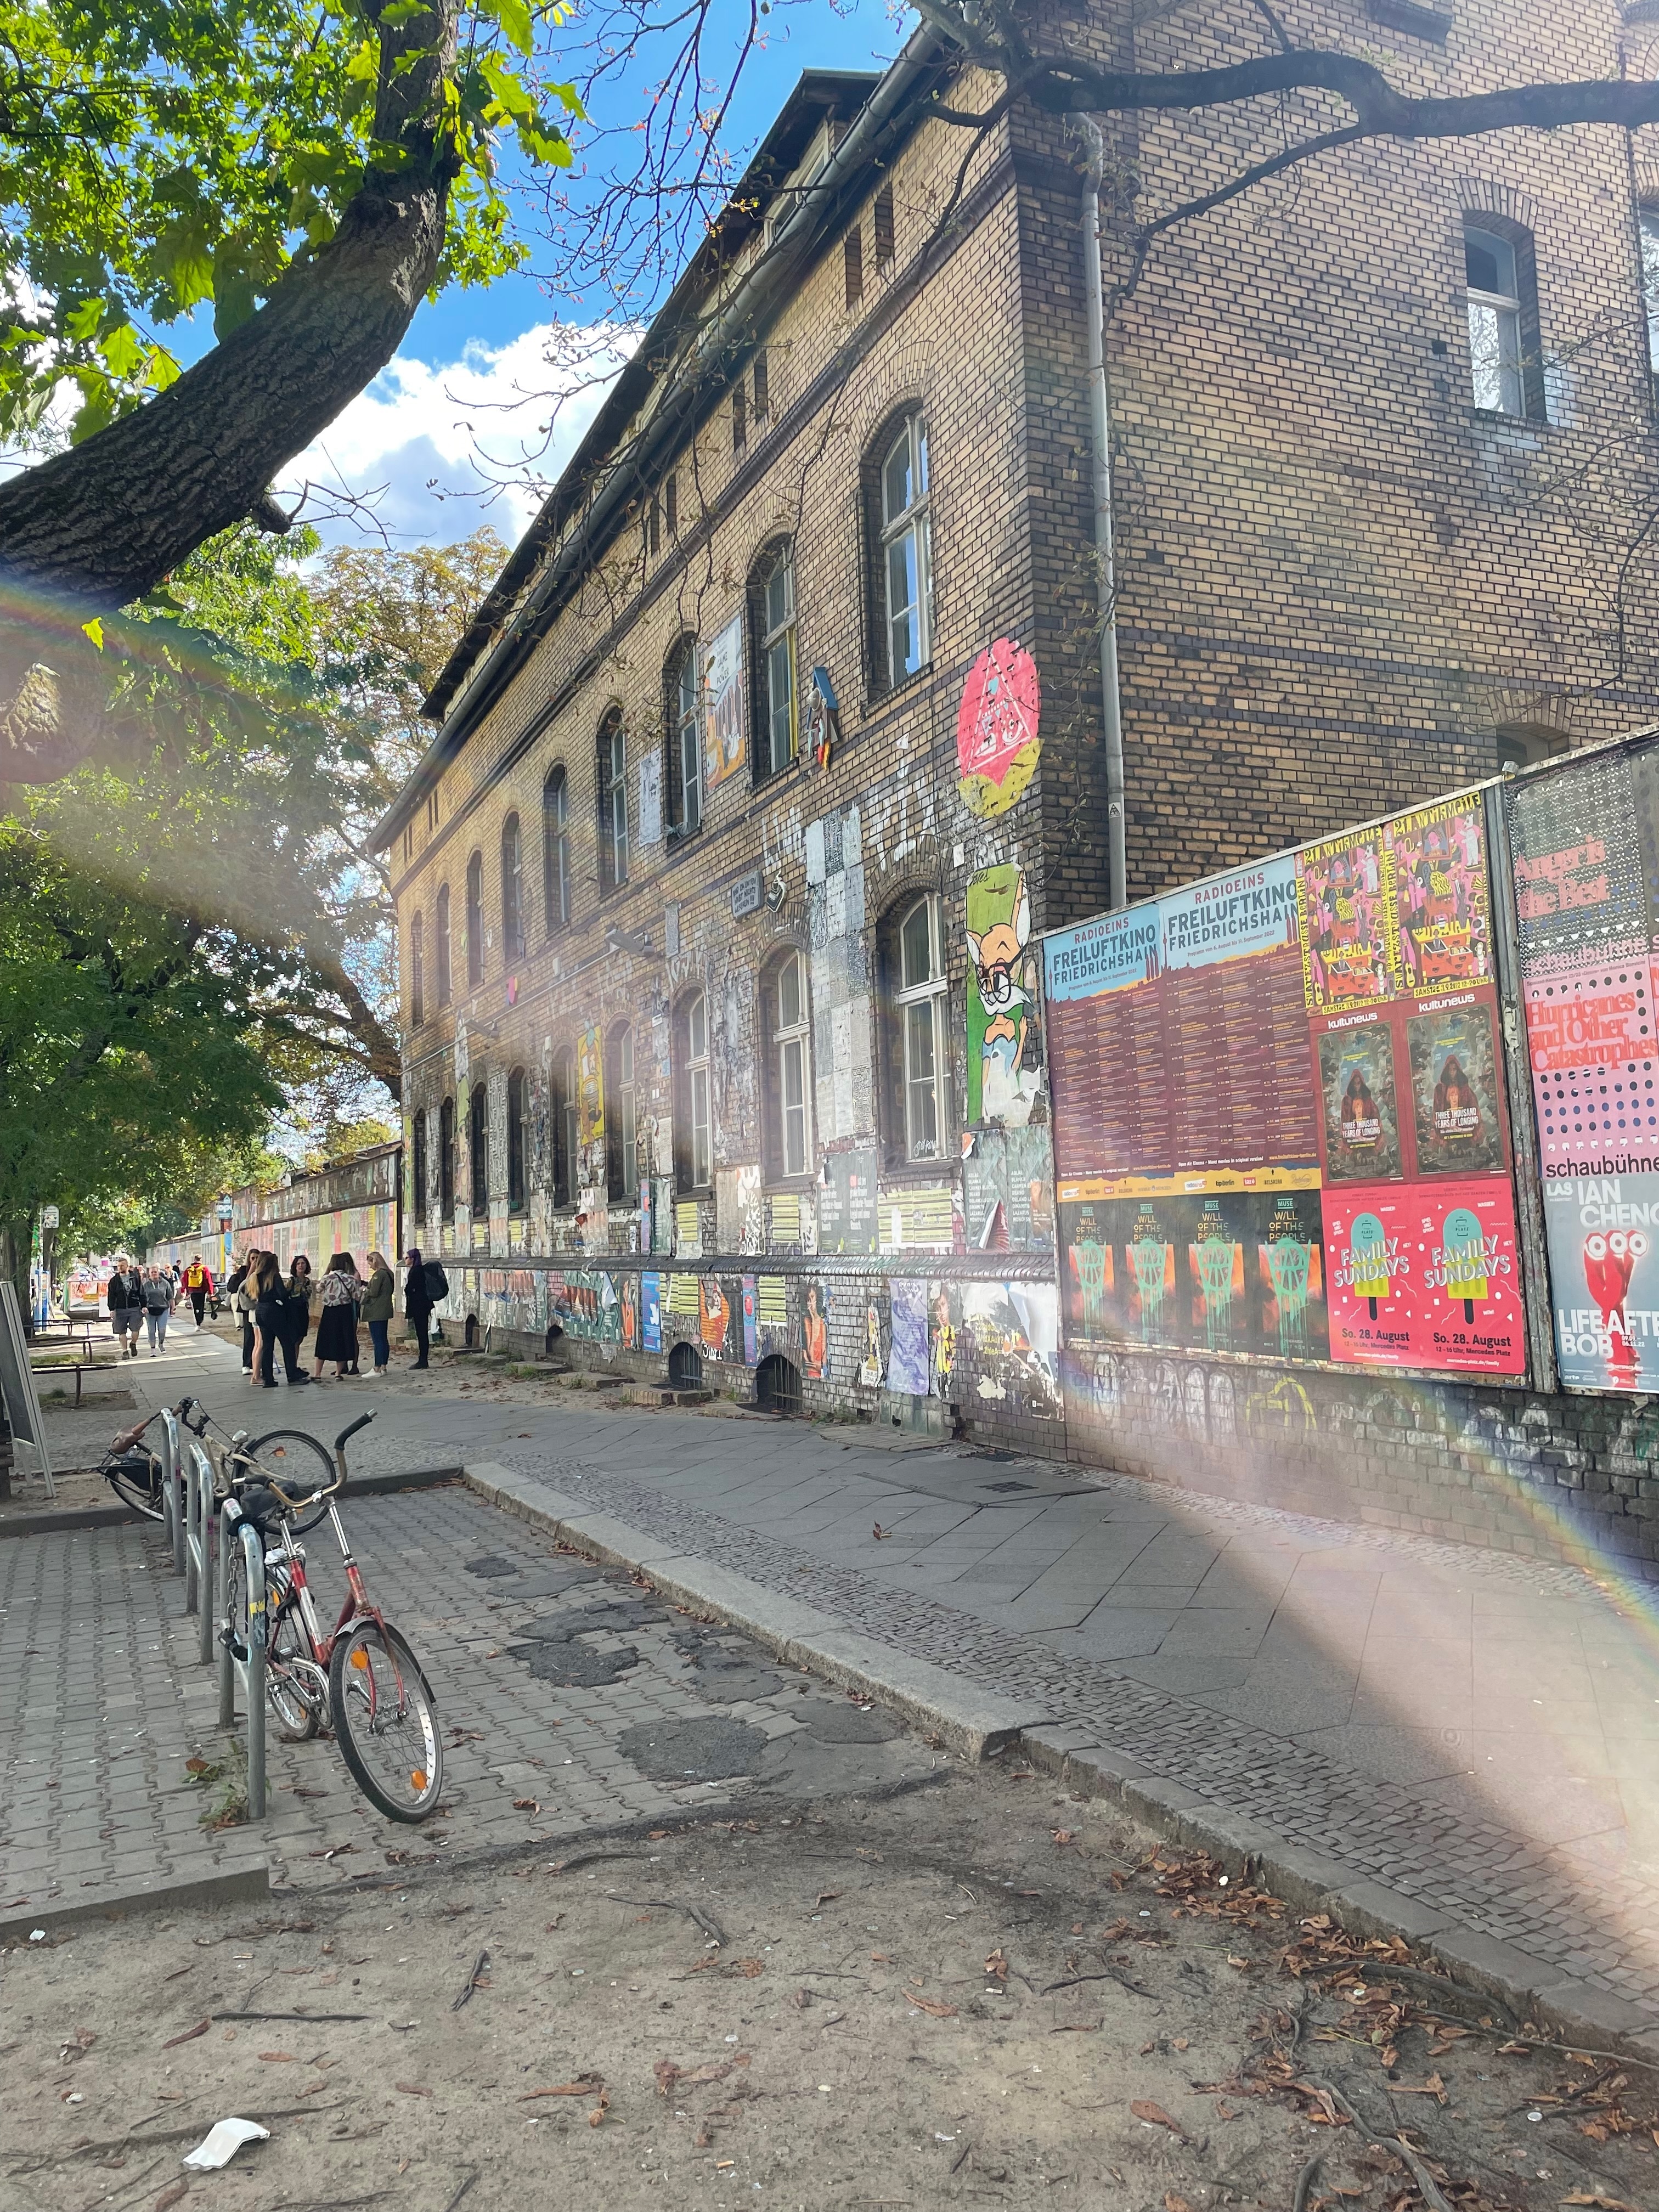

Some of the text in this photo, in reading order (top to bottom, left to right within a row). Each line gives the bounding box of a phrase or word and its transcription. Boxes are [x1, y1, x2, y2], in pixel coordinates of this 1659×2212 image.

[1195, 872, 1265, 904] RADIOEINS
[1168, 879, 1296, 935] FREILUFTKINO
[1075, 917, 1129, 945] RADIOEINS
[1170, 904, 1298, 951] FRIEDRICHSHAIN
[1244, 934, 1263, 943] September
[1053, 924, 1156, 972] FREILUFTKINO
[1054, 944, 1158, 985] FRIEDRICHSHAIN
[1526, 994, 1637, 1027] Hurricanes
[1528, 1017, 1629, 1050] and Other
[1531, 1036, 1659, 1072] Catastrophes
[1343, 1118, 1378, 1130] THREE THOUSAND
[1435, 1108, 1476, 1119] THREE THOUSAND
[1435, 1116, 1479, 1128] YEARS OF LONGING
[1342, 1130, 1356, 1138] YEARS
[1362, 1126, 1380, 1136] LONGING
[1577, 1179, 1621, 1205] IAN
[1138, 1215, 1157, 1223] WILL
[1198, 1222, 1229, 1231] OF THE
[1202, 1212, 1223, 1221] WILL
[1269, 1222, 1305, 1231] OF THE
[1274, 1211, 1298, 1220] WILL
[1086, 1226, 1101, 1234] THE
[1133, 1224, 1161, 1233] OF THE
[1341, 1237, 1399, 1266] FAMILY
[1431, 1234, 1498, 1266] FAMILY
[1334, 1255, 1410, 1288] SUNDAYS
[1424, 1255, 1511, 1288] SUNDAYS
[1558, 1309, 1604, 1334] LIFE
[1342, 1328, 1410, 1343] So. 28. August
[1434, 1333, 1511, 1348] So. 28. August
[1560, 1334, 1614, 1358] BOB
